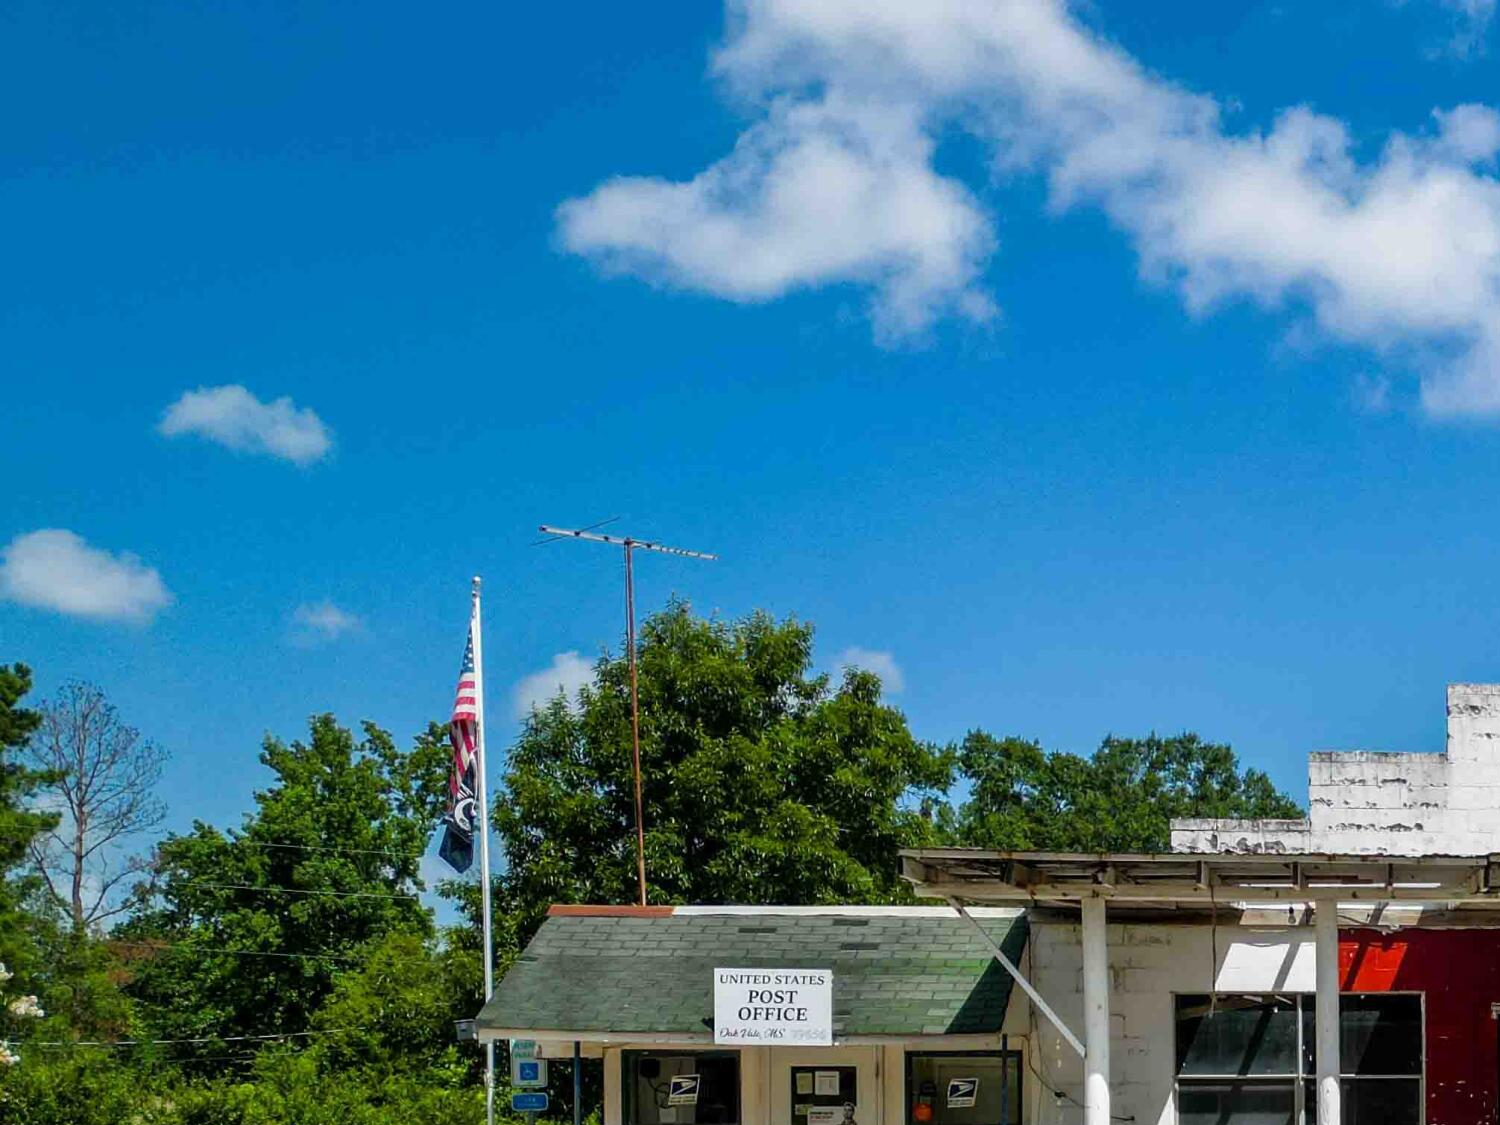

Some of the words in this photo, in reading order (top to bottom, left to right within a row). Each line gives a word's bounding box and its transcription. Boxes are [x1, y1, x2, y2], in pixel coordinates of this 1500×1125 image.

[720, 974, 771, 984] UNITED
[774, 975, 825, 985] STATES
[748, 990, 798, 1004] POST
[738, 1007, 808, 1021] OFFICE
[720, 1028, 739, 1038] Oak
